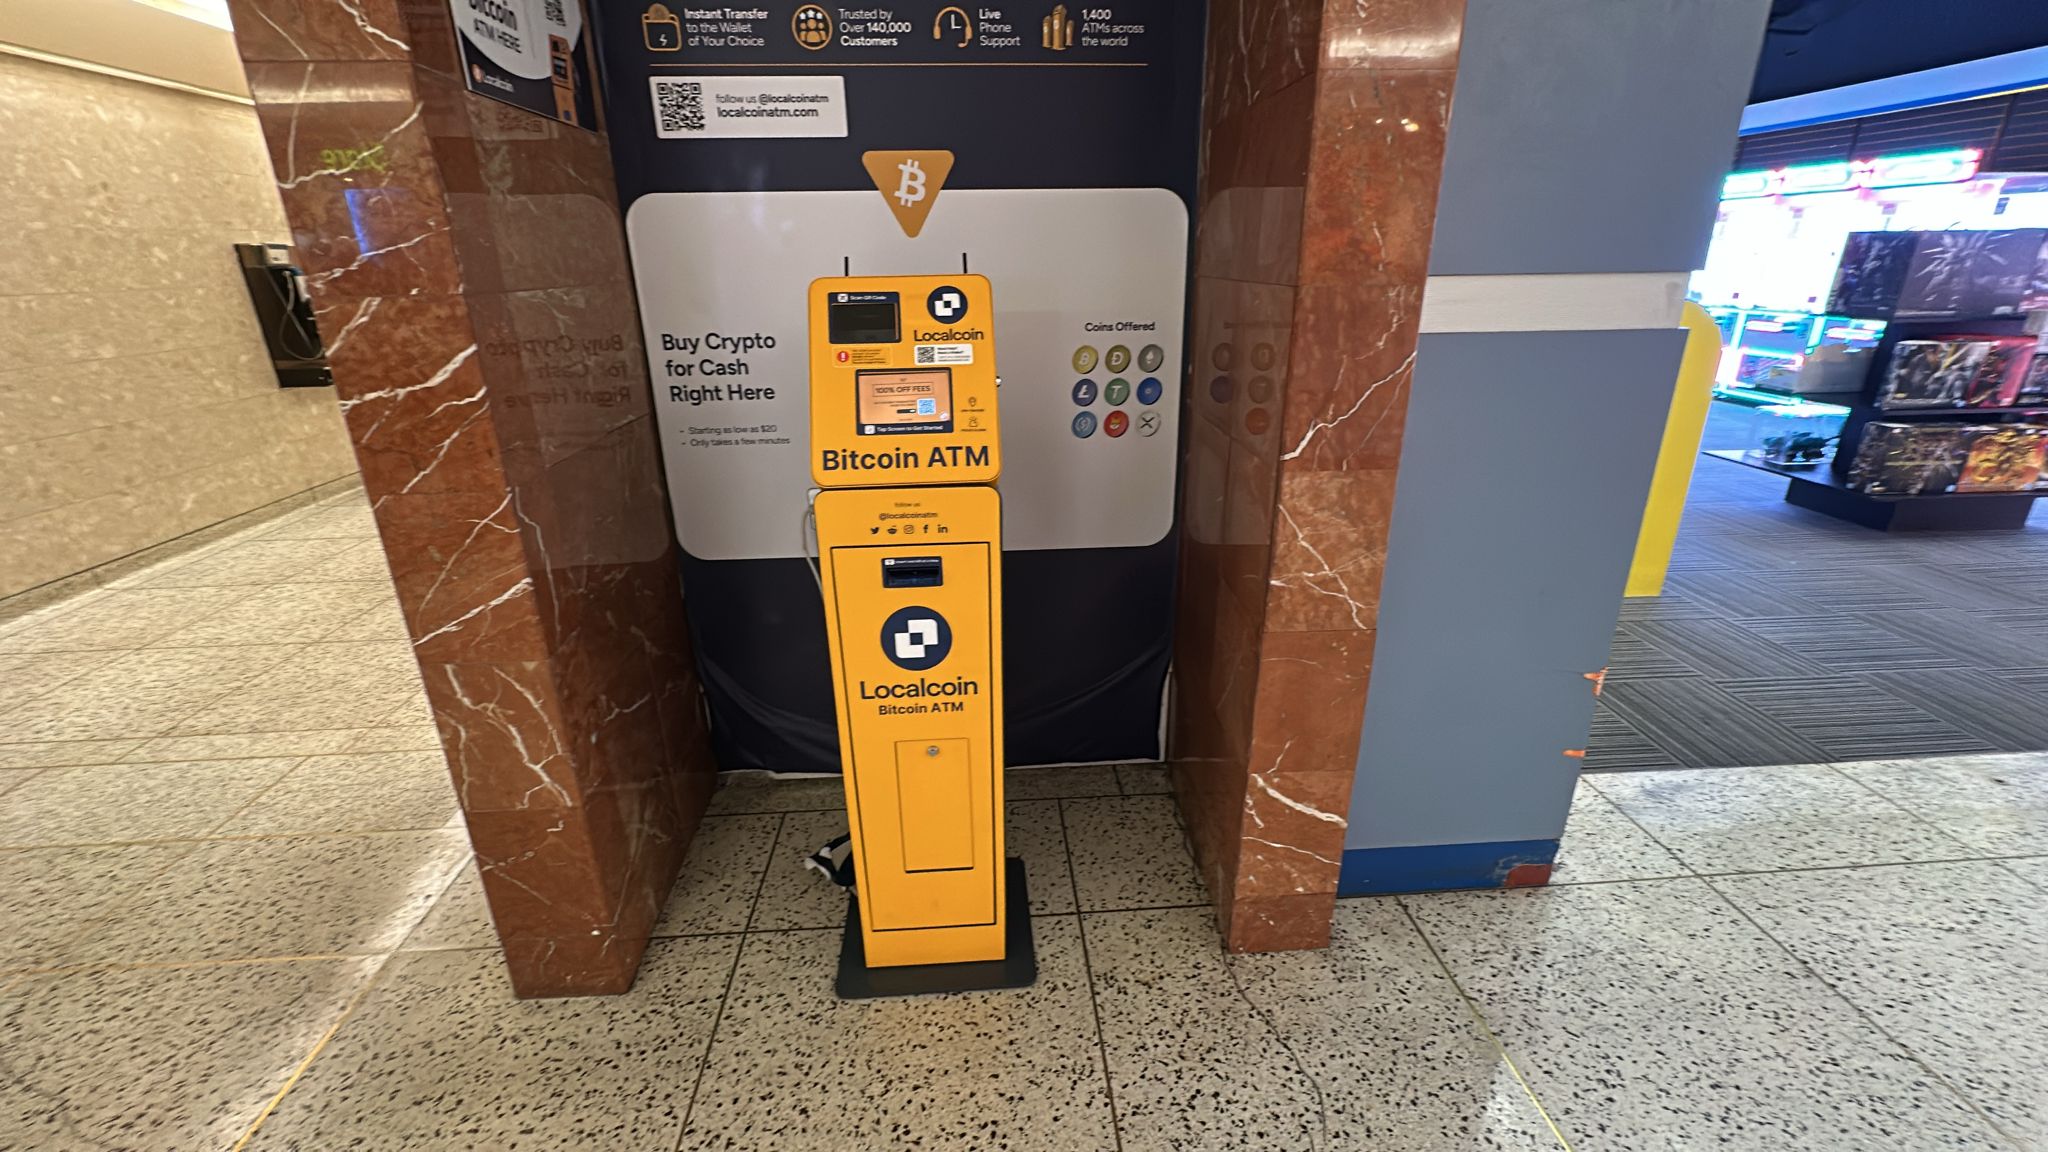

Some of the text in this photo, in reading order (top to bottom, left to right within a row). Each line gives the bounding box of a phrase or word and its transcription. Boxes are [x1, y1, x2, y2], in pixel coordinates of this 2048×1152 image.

[684, 8, 768, 19] Instant Transfer
[838, 9, 893, 22] Trusted by
[979, 9, 1002, 19] Live
[1081, 9, 1112, 21] 1,400
[686, 23, 752, 32] to the Wallet
[839, 22, 912, 34] Over 140,000
[979, 22, 1012, 33] Phone
[1081, 22, 1145, 33] ATMs across
[688, 35, 765, 46] of Your Choice
[840, 36, 898, 46] Customers
[979, 36, 1021, 48] Support
[1081, 36, 1129, 46] the world
[716, 93, 829, 105] follow us @localcoinatm
[717, 106, 819, 117] localcoinatm.com
[1084, 321, 1156, 332] Coins Offered
[914, 328, 984, 341] Localcoin
[661, 332, 776, 355] Buy Crypto
[665, 358, 749, 376] for Cash
[669, 384, 775, 406] Right Here
[687, 426, 722, 435] Starting
[760, 425, 777, 433] $20
[690, 439, 709, 448] Only
[822, 445, 989, 471] Bitcoin ATM
[879, 512, 938, 521] @localcoinatm
[860, 676, 979, 700] Localcoin
[878, 701, 964, 716] Bitcoin ATM
